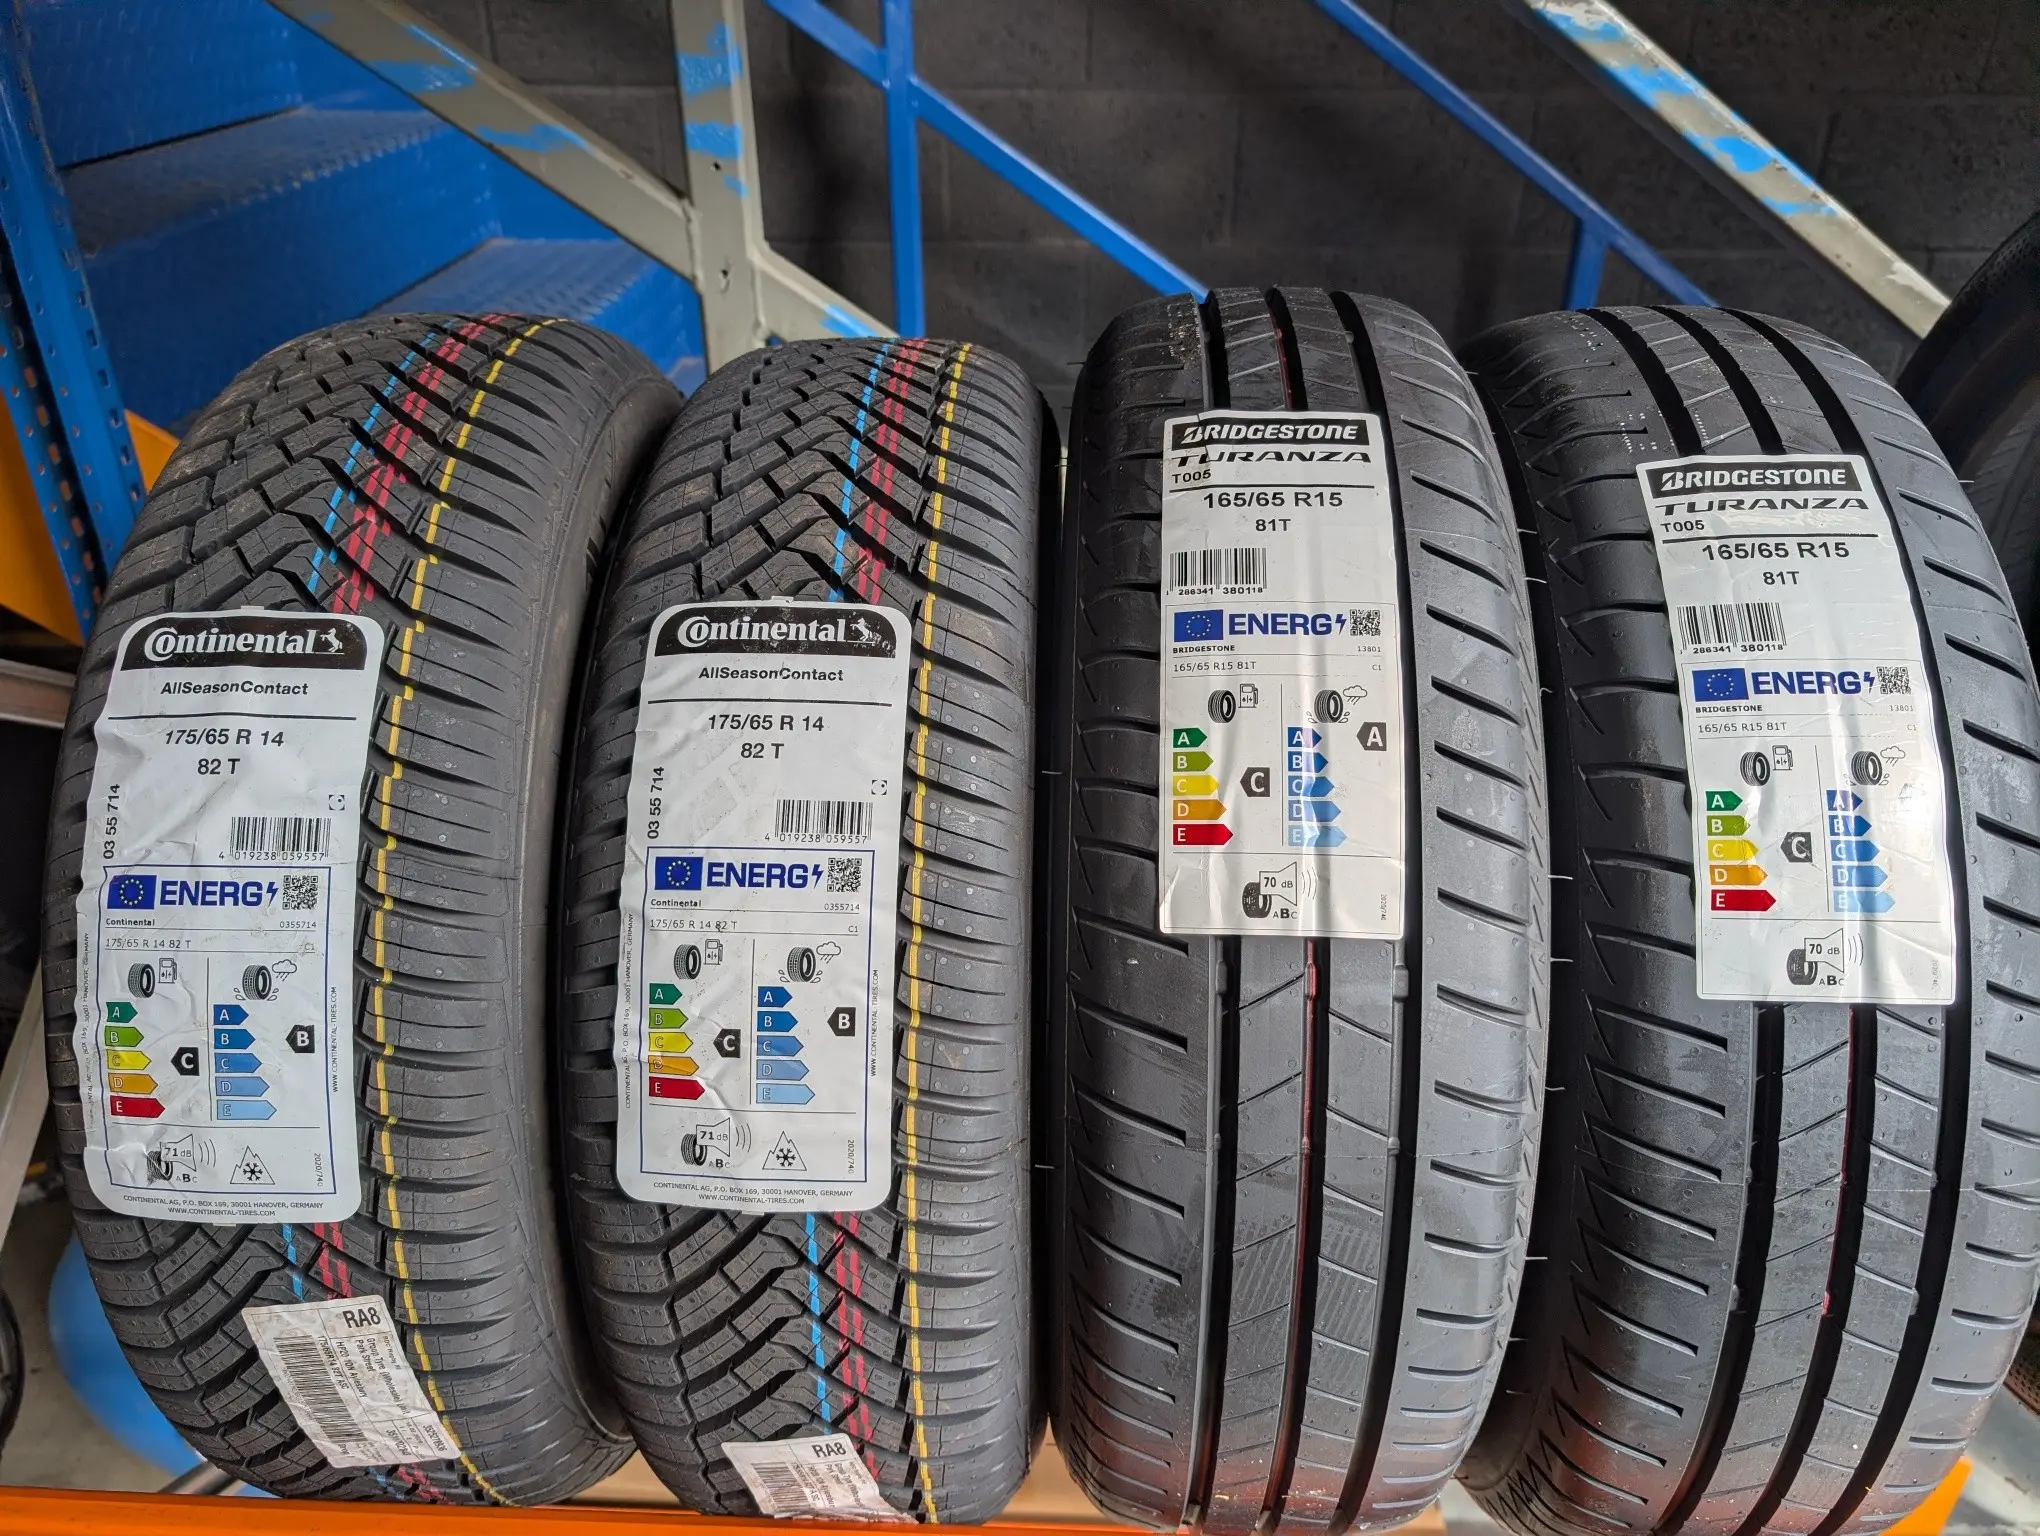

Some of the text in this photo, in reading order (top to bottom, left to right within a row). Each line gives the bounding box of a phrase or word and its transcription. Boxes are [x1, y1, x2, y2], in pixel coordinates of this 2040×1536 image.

[1182, 424, 1359, 444] BRIDGESTONE
[1172, 452, 1371, 467] TURANZA
[1172, 469, 1212, 483] T005
[1661, 469, 1847, 491] BRIDGESTONE
[1203, 492, 1343, 509] 165/65 R15
[1656, 498, 1869, 516] TURANZA
[1255, 519, 1291, 532] 81T
[1661, 520, 1705, 533] T005
[1702, 542, 1850, 560] 165/65 R15
[1763, 571, 1800, 585] 81T
[1223, 587, 1263, 595] 380118
[1229, 613, 1333, 635] ENERG
[678, 616, 846, 647] Continental
[144, 628, 316, 662] Continental
[1173, 645, 1235, 654] BRIDGESTONE
[1741, 644, 1783, 653] 380118
[1173, 662, 1256, 672] 165/65 R15 81T
[699, 668, 844, 682] AllSeasonContact
[160, 680, 308, 695] AllSeasonContact
[1751, 671, 1862, 695] ENERG
[1695, 705, 1763, 713] BRIDGESTONE
[708, 714, 824, 732] 175/65 R 14
[1698, 722, 1787, 733] 165/65 R15 81T
[165, 729, 284, 747] 175/65 R 14
[1177, 732, 1190, 745] A
[1367, 727, 1384, 747] A
[741, 743, 785, 759] 82 T
[198, 758, 240, 775] 82 T
[1177, 755, 1188, 768] B
[1176, 779, 1187, 793] C
[1250, 772, 1265, 792] C
[647, 766, 665, 839] 03 55 714
[1711, 795, 1724, 808] A
[1177, 804, 1190, 817] D
[103, 784, 120, 859] 03 55 714
[1711, 819, 1723, 832] B
[765, 834, 867, 844] 4 019238 059557
[1177, 828, 1186, 841] E
[1712, 844, 1724, 858] C
[1792, 836, 1806, 858] C
[218, 852, 225, 860] 4
[707, 862, 808, 889] ENERG
[1715, 869, 1728, 882] D
[1264, 877, 1293, 888] 70 dB
[160, 880, 264, 906] ENERG
[651, 899, 701, 908] Continental
[824, 903, 860, 911] 0355714
[1716, 893, 1726, 908] E
[106, 918, 155, 926] Continental
[280, 921, 316, 929] 0355714
[650, 919, 738, 930] 175/65 R 14 82 T
[106, 938, 191, 949] 175/65 R 14 82 T
[1809, 943, 1840, 955] 70 dB
[655, 991, 664, 1001] A
[764, 992, 773, 1002] A
[112, 1007, 120, 1018] A
[220, 1010, 229, 1020] A
[655, 1014, 663, 1024] B
[764, 1016, 772, 1027] B
[838, 1014, 850, 1029] B
[111, 1032, 118, 1043] B
[221, 1034, 229, 1045] B
[297, 1032, 309, 1046] B
[656, 1037, 664, 1048] C
[723, 1035, 735, 1051] C
[764, 1041, 771, 1052] C
[112, 1056, 120, 1067] C
[180, 1053, 194, 1069] C
[221, 1058, 229, 1069] C
[763, 1065, 772, 1076] D
[114, 1078, 123, 1088] D
[222, 1082, 231, 1092] D
[655, 1083, 661, 1094] E
[763, 1088, 770, 1100] E
[116, 1102, 123, 1112] E
[223, 1105, 231, 1116] E
[700, 1131, 715, 1140] 71
[164, 1148, 178, 1157] 71
[654, 1181, 699, 1191] CONTINENTAL
[820, 1189, 853, 1197] GERMANY
[124, 1194, 169, 1205] CONTINENTAL
[343, 1307, 381, 1329] RA8
[812, 1442, 847, 1458] RA8
